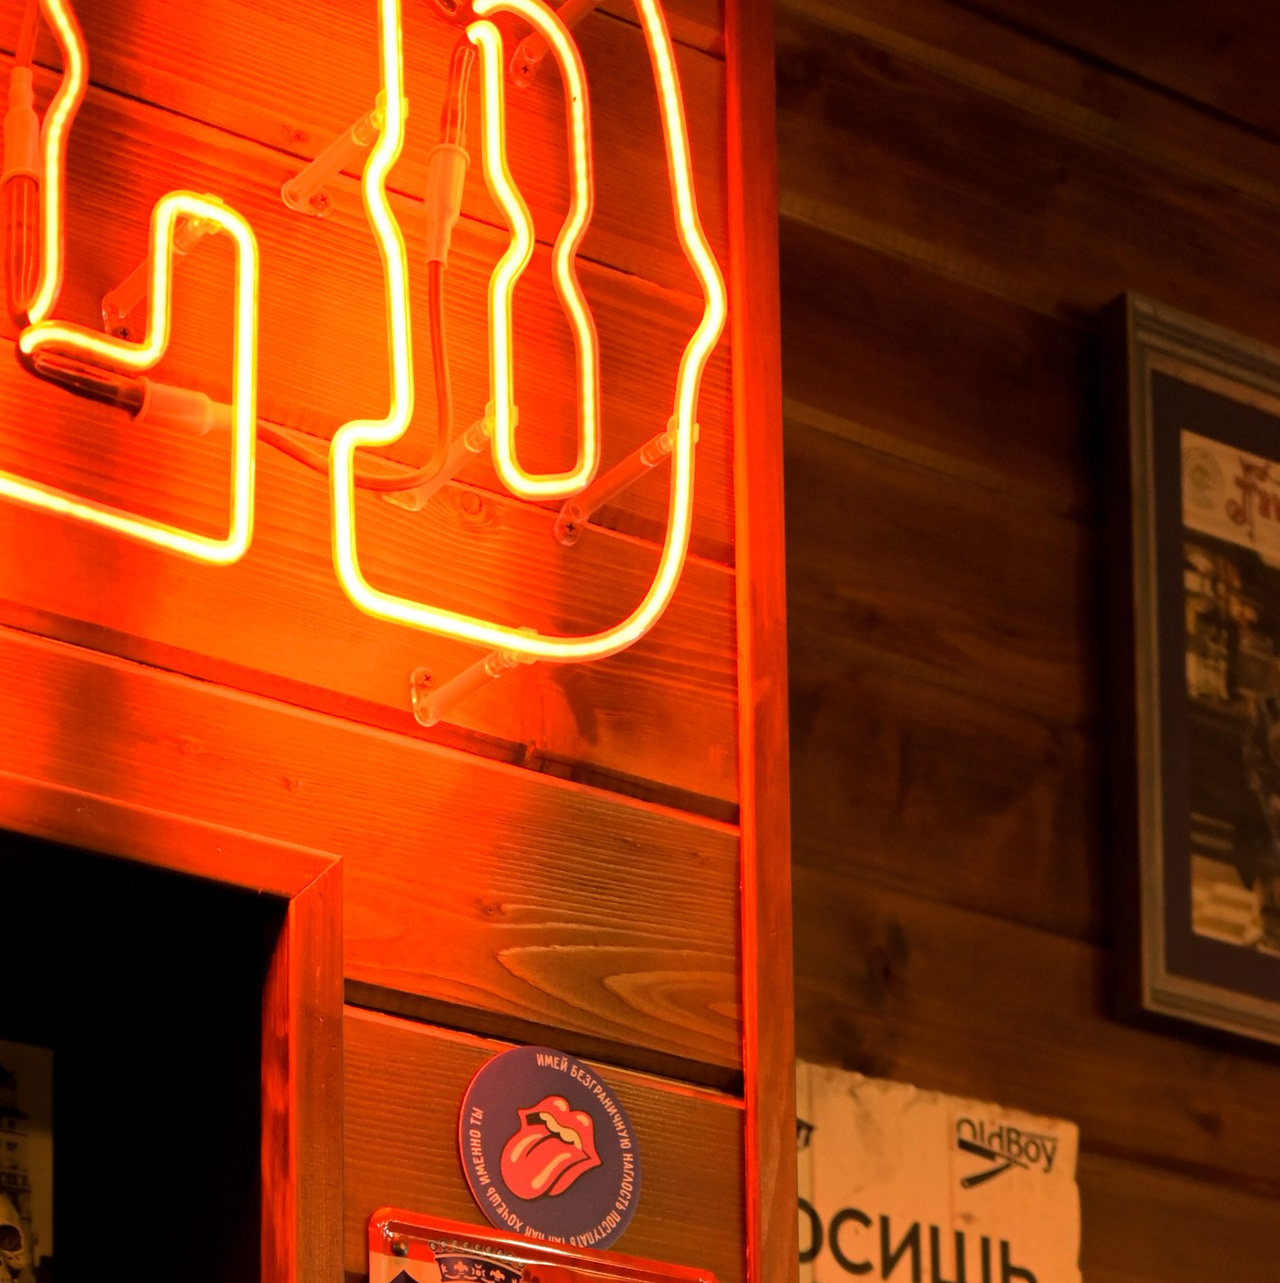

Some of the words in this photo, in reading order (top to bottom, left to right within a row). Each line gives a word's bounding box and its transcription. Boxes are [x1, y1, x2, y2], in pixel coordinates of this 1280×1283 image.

[536, 1053, 569, 1073] ИМЕЙ
[469, 1106, 484, 1126] ТЫ
[570, 1065, 632, 1149] БЕЗГРАНИЧНУЮ
[469, 1130, 490, 1186] ИМЕННО
[955, 1116, 1058, 1172] OldBoy
[486, 1186, 522, 1232] ХОЧЕШЬ
[616, 1153, 635, 1211] НАГЛОСТЬ
